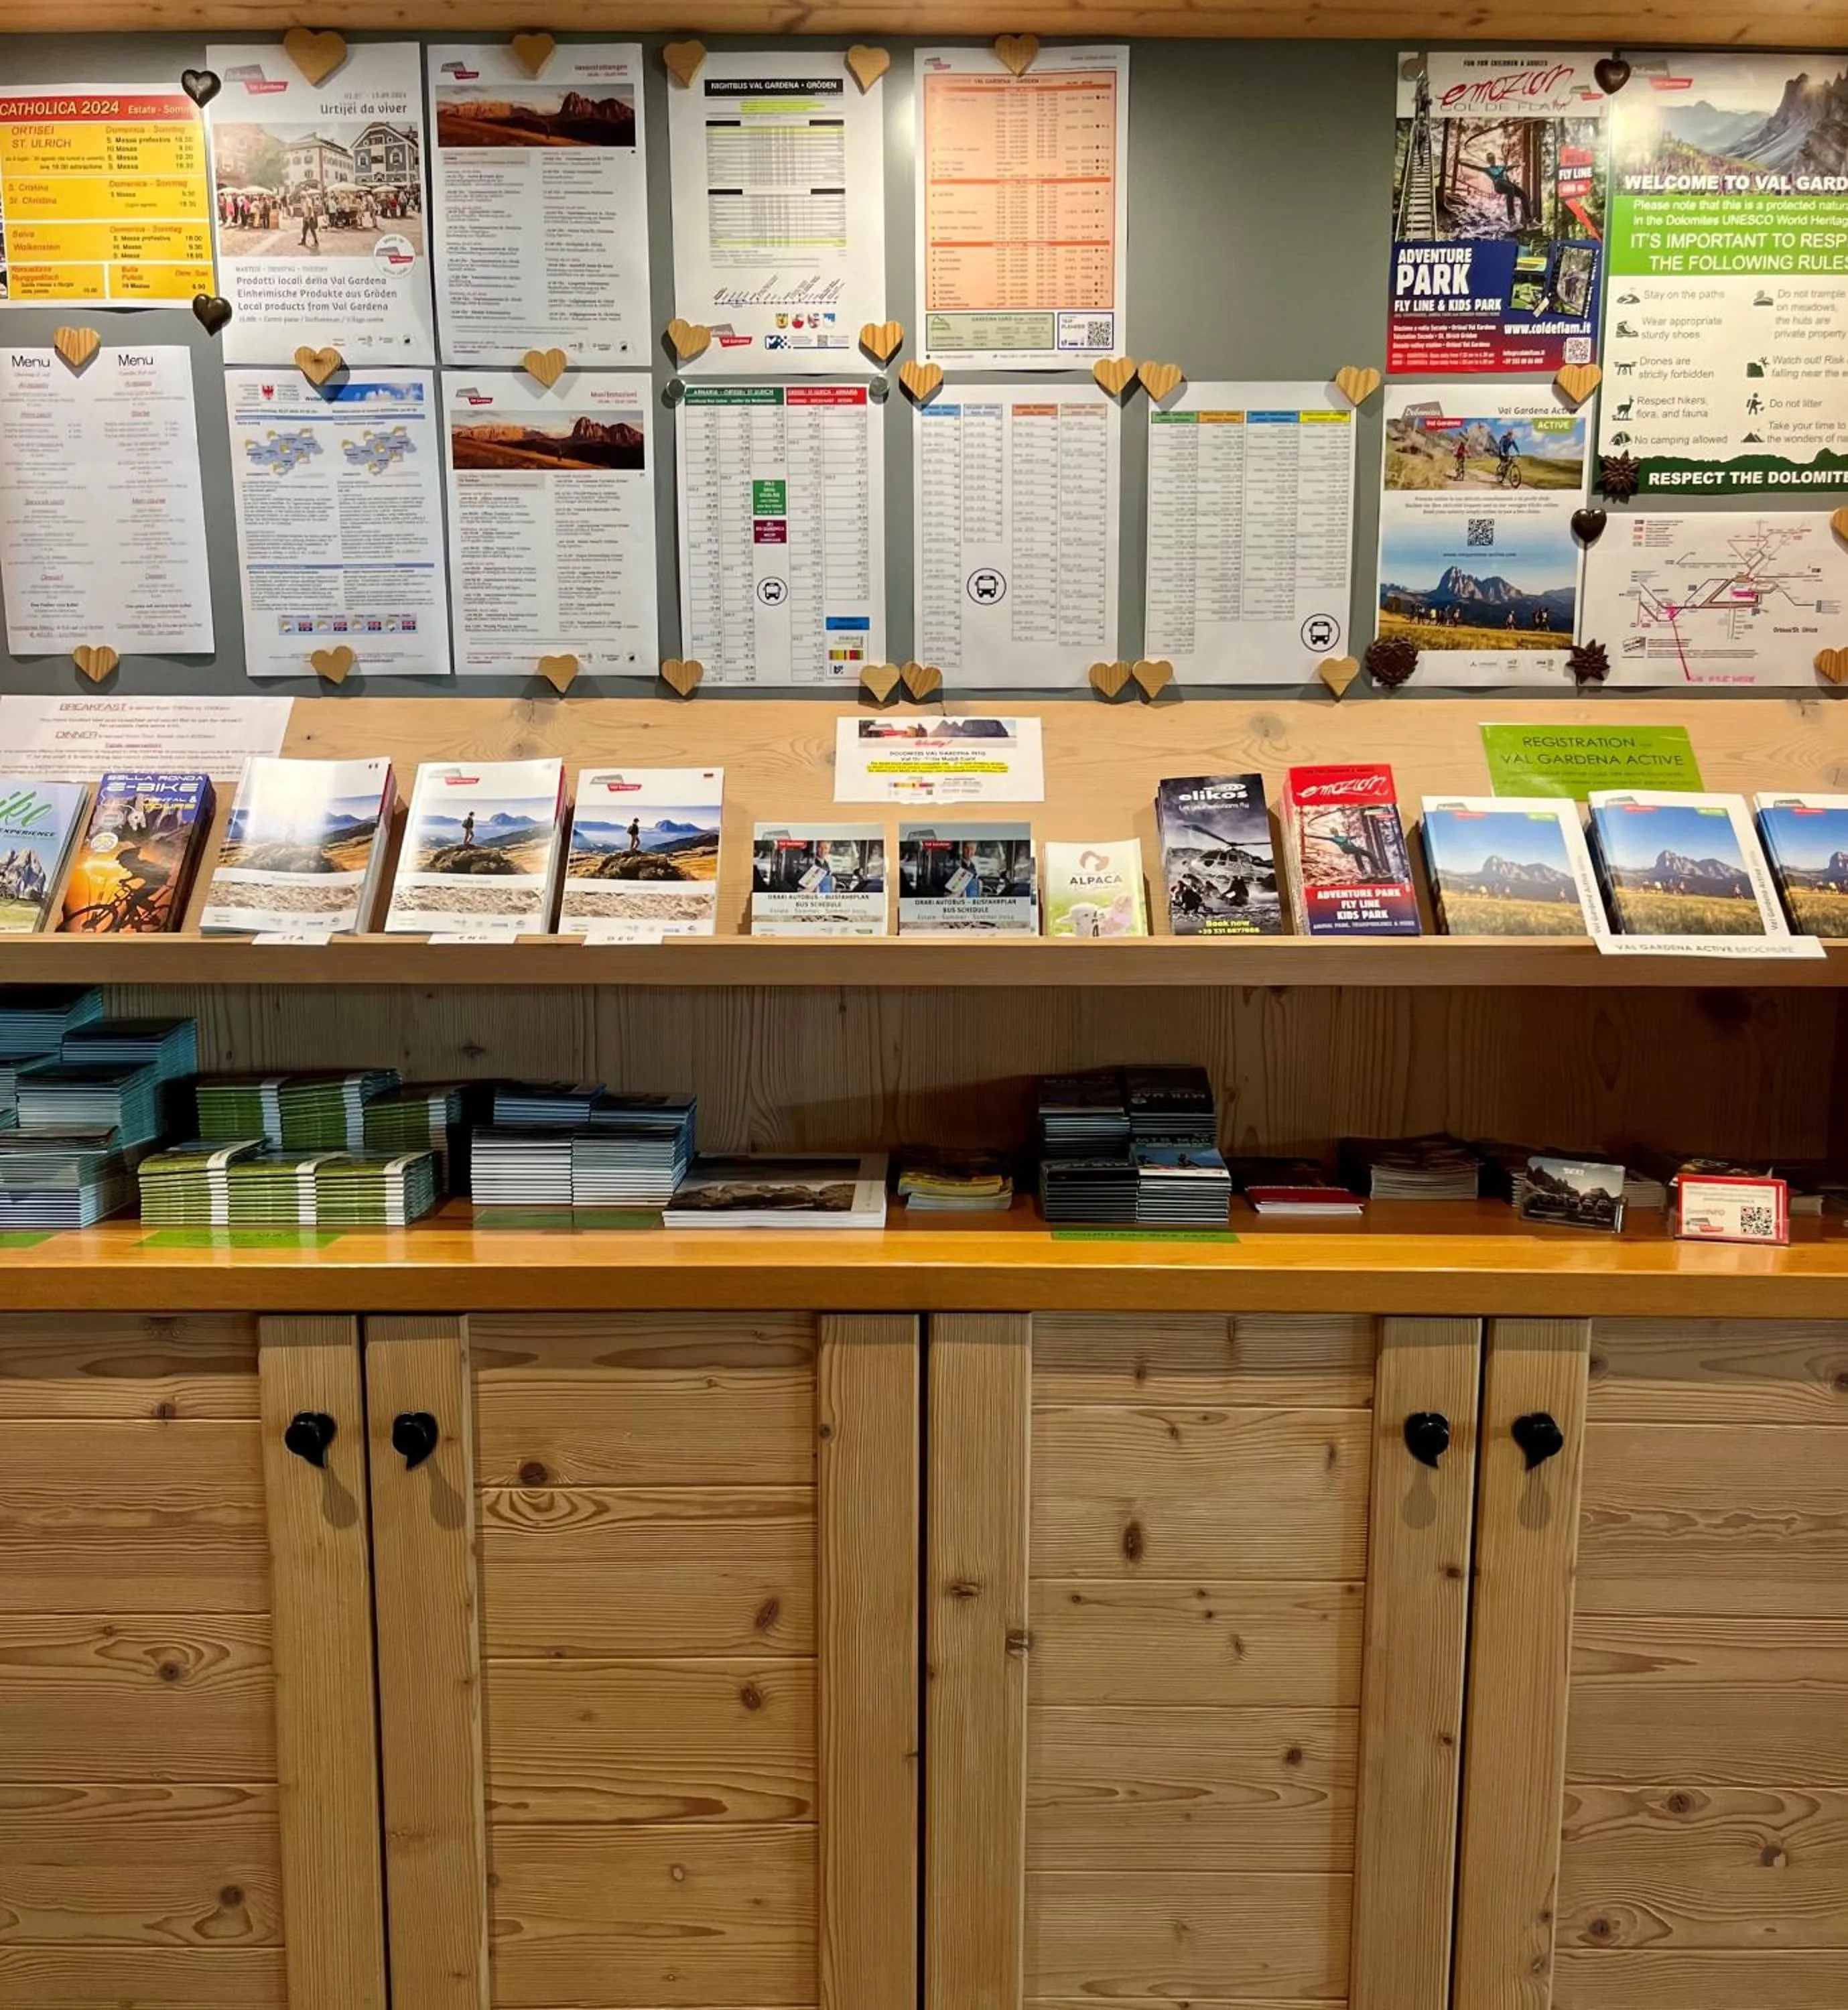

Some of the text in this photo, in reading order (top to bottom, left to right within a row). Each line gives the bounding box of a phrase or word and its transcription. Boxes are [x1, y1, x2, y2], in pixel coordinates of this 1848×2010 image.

[711, 80, 837, 90] NIGHTBUS VAL GARDENA GRÖDEN
[0, 100, 156, 117] CATHOLICA 2024 Estate
[360, 102, 407, 114] da viver
[1484, 102, 1509, 113] DE
[11, 125, 54, 135] ORTISEI
[31, 138, 72, 149] ULRICH
[1559, 168, 1592, 180] FLY LINE
[1625, 174, 1848, 191] WELCOME TO VAL GARD
[1634, 199, 1816, 212] Please note that this is a protected
[1634, 215, 1643, 225] in
[1646, 214, 1663, 225] the
[1666, 214, 1719, 226] Dolomites
[1722, 214, 1774, 226] UNESCO
[1776, 214, 1808, 226] World
[1631, 232, 1848, 249] IT'S IMPORTANT TO RESP
[1398, 247, 1473, 264] ADVENTURE
[1650, 255, 1683, 271] THE
[1689, 255, 1793, 271] FOLLOWING
[237, 276, 387, 285] Prodotti locali della Val Gardena
[1396, 263, 1471, 295] PARK
[238, 289, 297, 299] Einheimische
[300, 289, 343, 299] Produkte
[345, 290, 361, 299] aus
[1642, 289, 1664, 301] Stay
[1681, 290, 1696, 299] the
[1698, 289, 1725, 302] paths
[1777, 289, 1846, 301] Do not trample
[238, 302, 389, 312] Local products from Val Gardena
[1394, 297, 1502, 312] FLY LINE & KIDS PARK
[1776, 304, 1788, 312] on
[1642, 316, 1723, 329] Wear appropriate
[1775, 316, 1831, 326] the huts are
[1504, 321, 1591, 334] www.coldeflam.it
[1641, 330, 1700, 342] sturdy shoes
[1774, 329, 1846, 341] private property
[11, 354, 50, 368] Menu
[118, 354, 153, 367] Menu
[1640, 356, 1672, 366] Drones
[1773, 355, 1806, 365] Watch
[1824, 355, 1845, 365] Risk
[1638, 368, 1714, 380] strictly forbidden
[1772, 368, 1799, 380] falling
[1825, 368, 1840, 378] the
[1637, 395, 1675, 407] Respect
[1769, 398, 1823, 408] Do not litter
[1498, 407, 1549, 415] Val Gardena
[1661, 409, 1680, 418] and
[1682, 408, 1708, 418] fauna
[1537, 421, 1571, 430] ACTIVE
[1769, 421, 1847, 431] Take your time to
[1634, 434, 1728, 446] No camping allowed
[1767, 434, 1835, 444] the wonders of
[1648, 471, 1725, 486] RESPECT
[1729, 471, 1764, 484] THE
[60, 702, 128, 712] BREAKFAST
[55, 730, 98, 740] DINNER
[1522, 736, 1636, 749] REGISTRATION
[1500, 754, 1684, 766] VAL GARDENA ACTIVE
[106, 782, 200, 793] E-BIKE
[189, 795, 198, 803] &
[1179, 789, 1249, 802] elikos
[1069, 874, 1123, 885] ALPACA
[1317, 888, 1401, 900] ADVENTURE PARK
[1341, 899, 1381, 909] FLY LINE
[1337, 909, 1389, 920] KIDS PARK
[1640, 944, 1693, 952] GARDENA
[1695, 944, 1735, 953] ACTIVE
